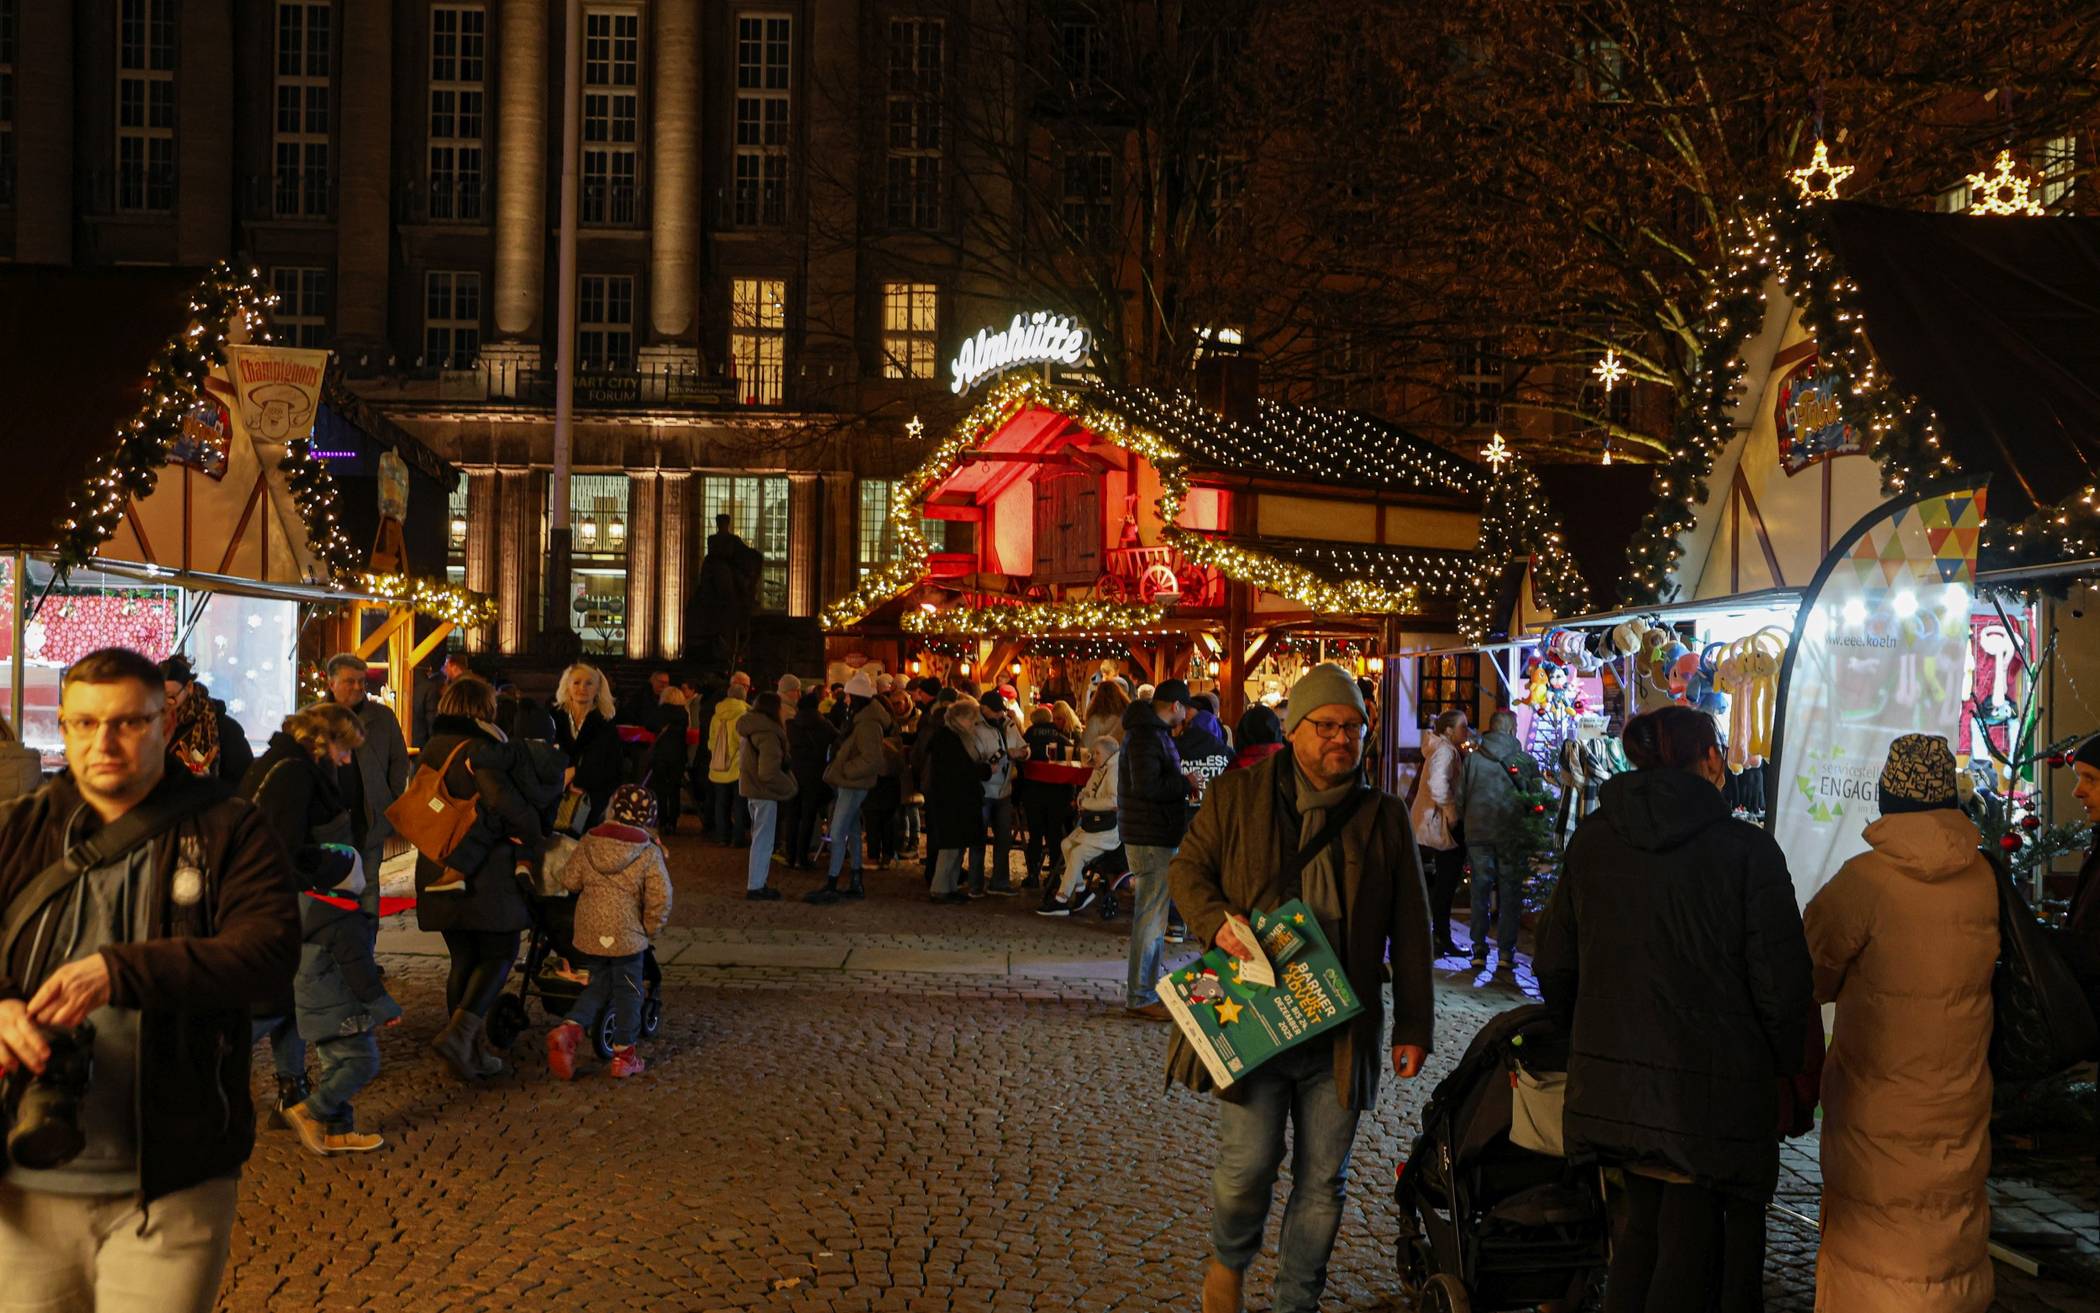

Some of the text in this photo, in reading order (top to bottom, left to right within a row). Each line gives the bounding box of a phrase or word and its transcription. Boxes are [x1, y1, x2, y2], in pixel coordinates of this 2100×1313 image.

[951, 311, 1084, 394] Almhütte
[240, 359, 320, 387] Champignons
[607, 376, 638, 390] CITY
[589, 391, 636, 402] FORUM
[1822, 764, 1881, 779] servicestell
[1820, 776, 1880, 803] ENGAGE
[1281, 973, 1322, 1025] ADVENT
[1297, 961, 1336, 1017] BARMER
[1273, 996, 1302, 1036] DEZEMBER
[1278, 1020, 1294, 1041] 2025
